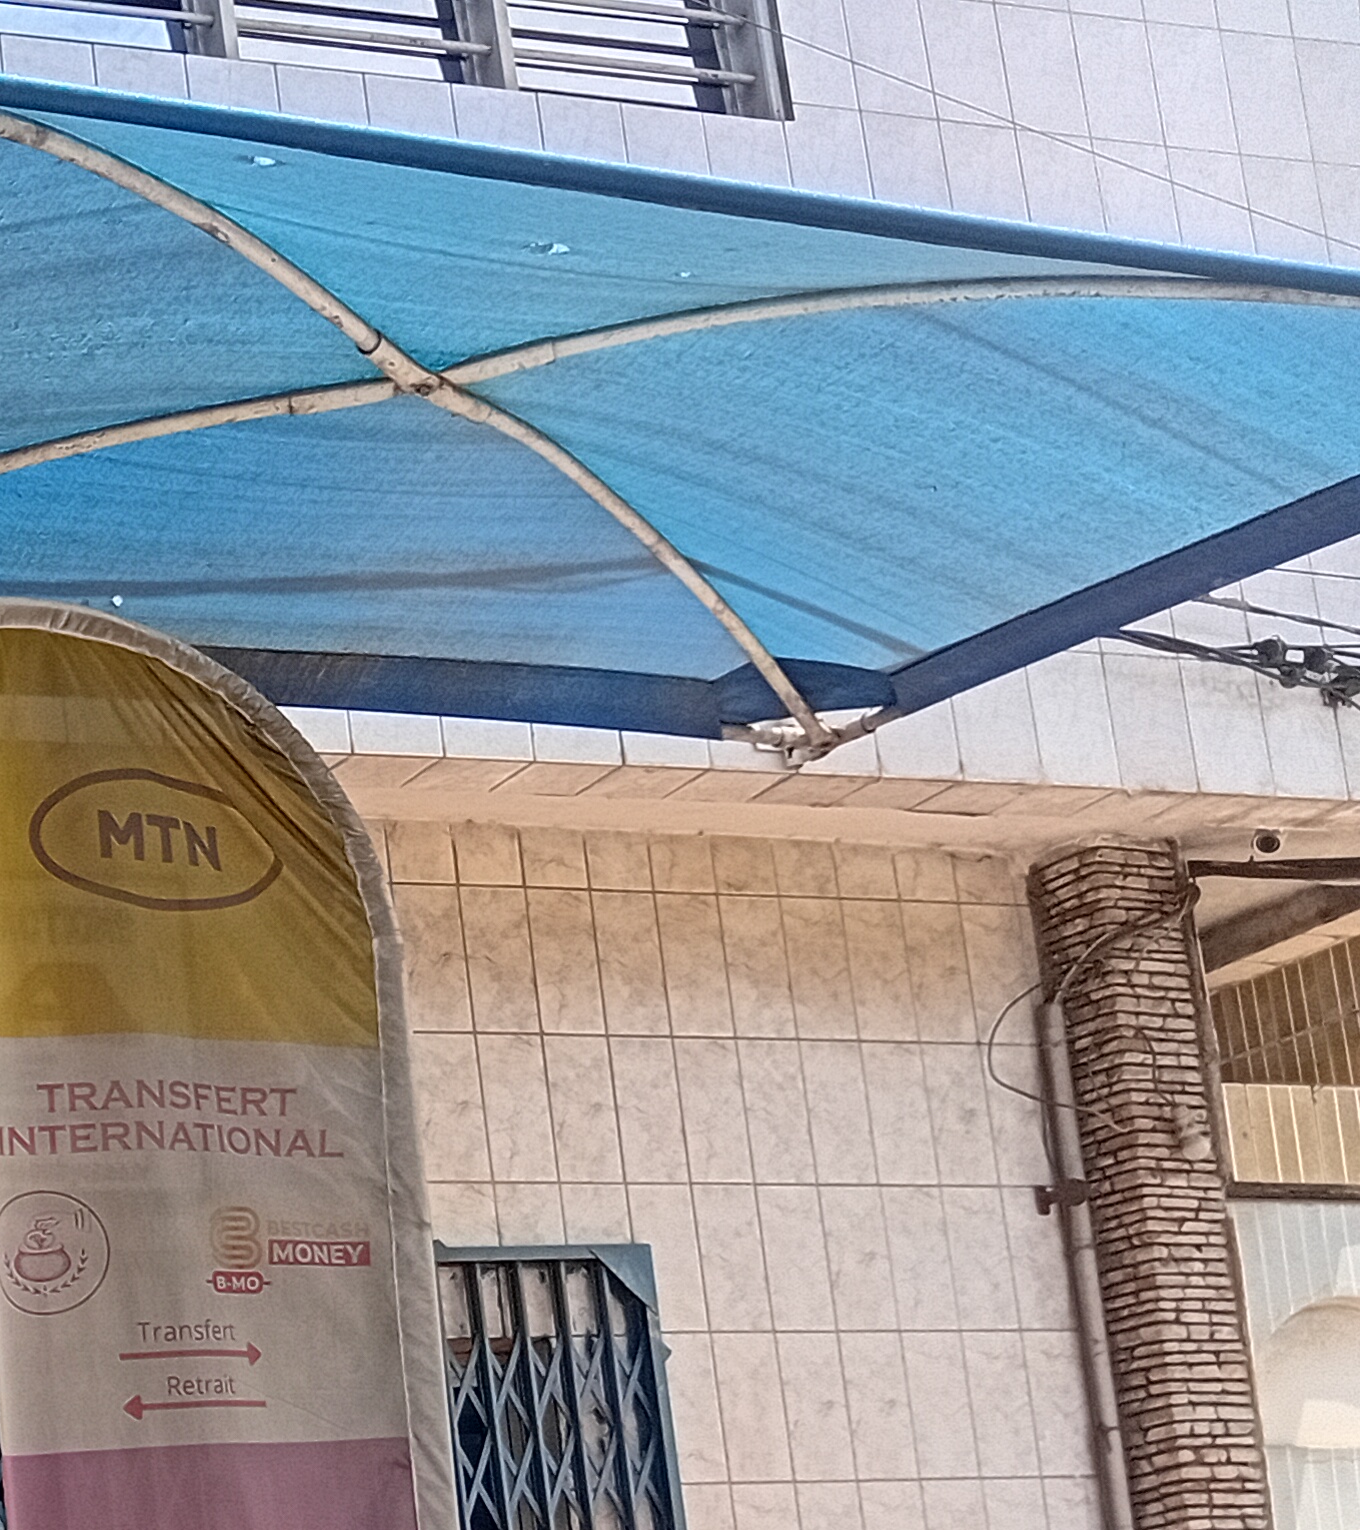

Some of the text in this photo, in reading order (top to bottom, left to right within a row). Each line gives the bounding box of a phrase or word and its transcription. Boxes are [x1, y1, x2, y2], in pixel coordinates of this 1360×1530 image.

[97, 810, 222, 872] MTN
[36, 1079, 298, 1117] TRANSFERT
[267, 1219, 370, 1240] BESTCASH
[271, 1242, 365, 1265] MONEY
[215, 1275, 261, 1291] B-MO
[166, 1375, 236, 1396] Retrait
